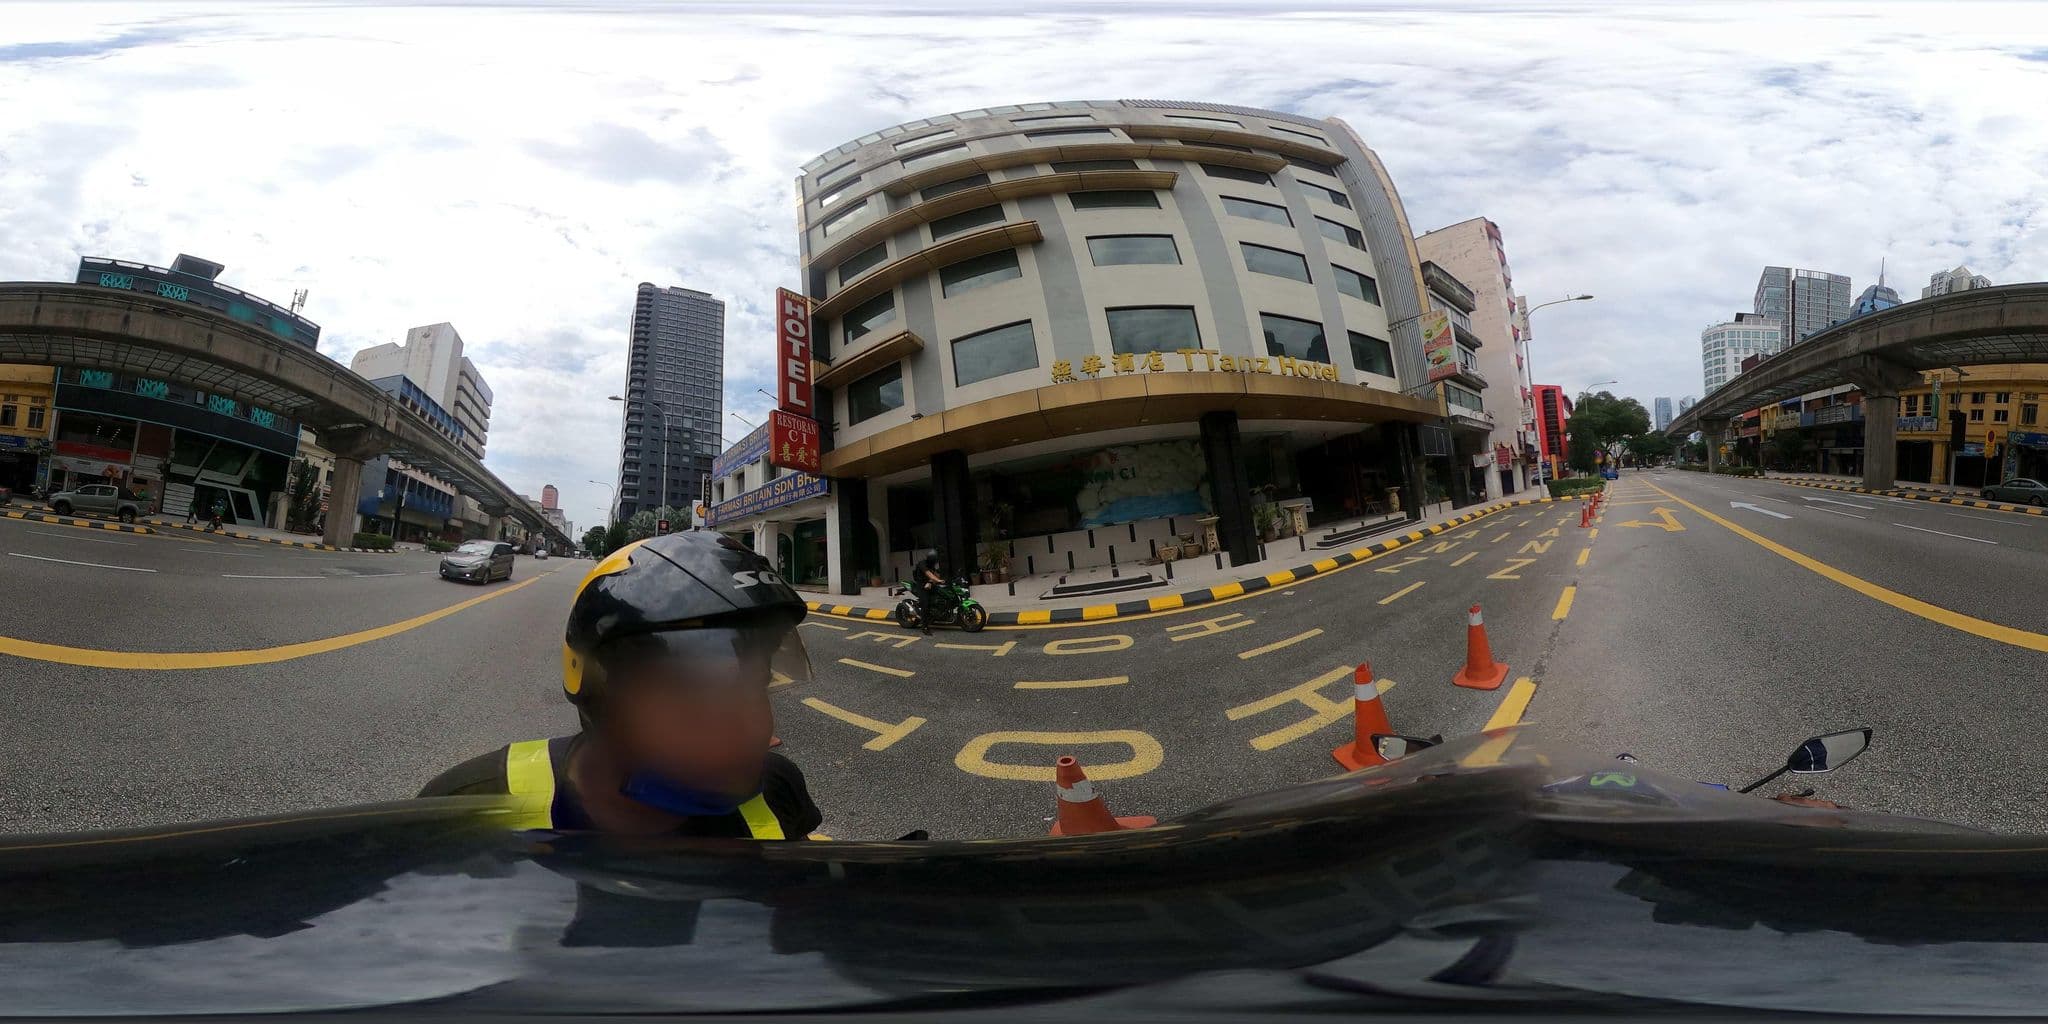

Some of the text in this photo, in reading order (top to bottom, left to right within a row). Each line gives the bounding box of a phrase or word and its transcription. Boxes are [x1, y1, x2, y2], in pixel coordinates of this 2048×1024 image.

[784, 299, 807, 407] HOTEL
[1177, 348, 1272, 374] TTanz
[1278, 356, 1340, 382] Hotel
[777, 413, 816, 435] RESTORAN
[718, 499, 741, 515] FARMASI
[743, 486, 772, 506] BRITAIN
[774, 477, 794, 496] SDN
